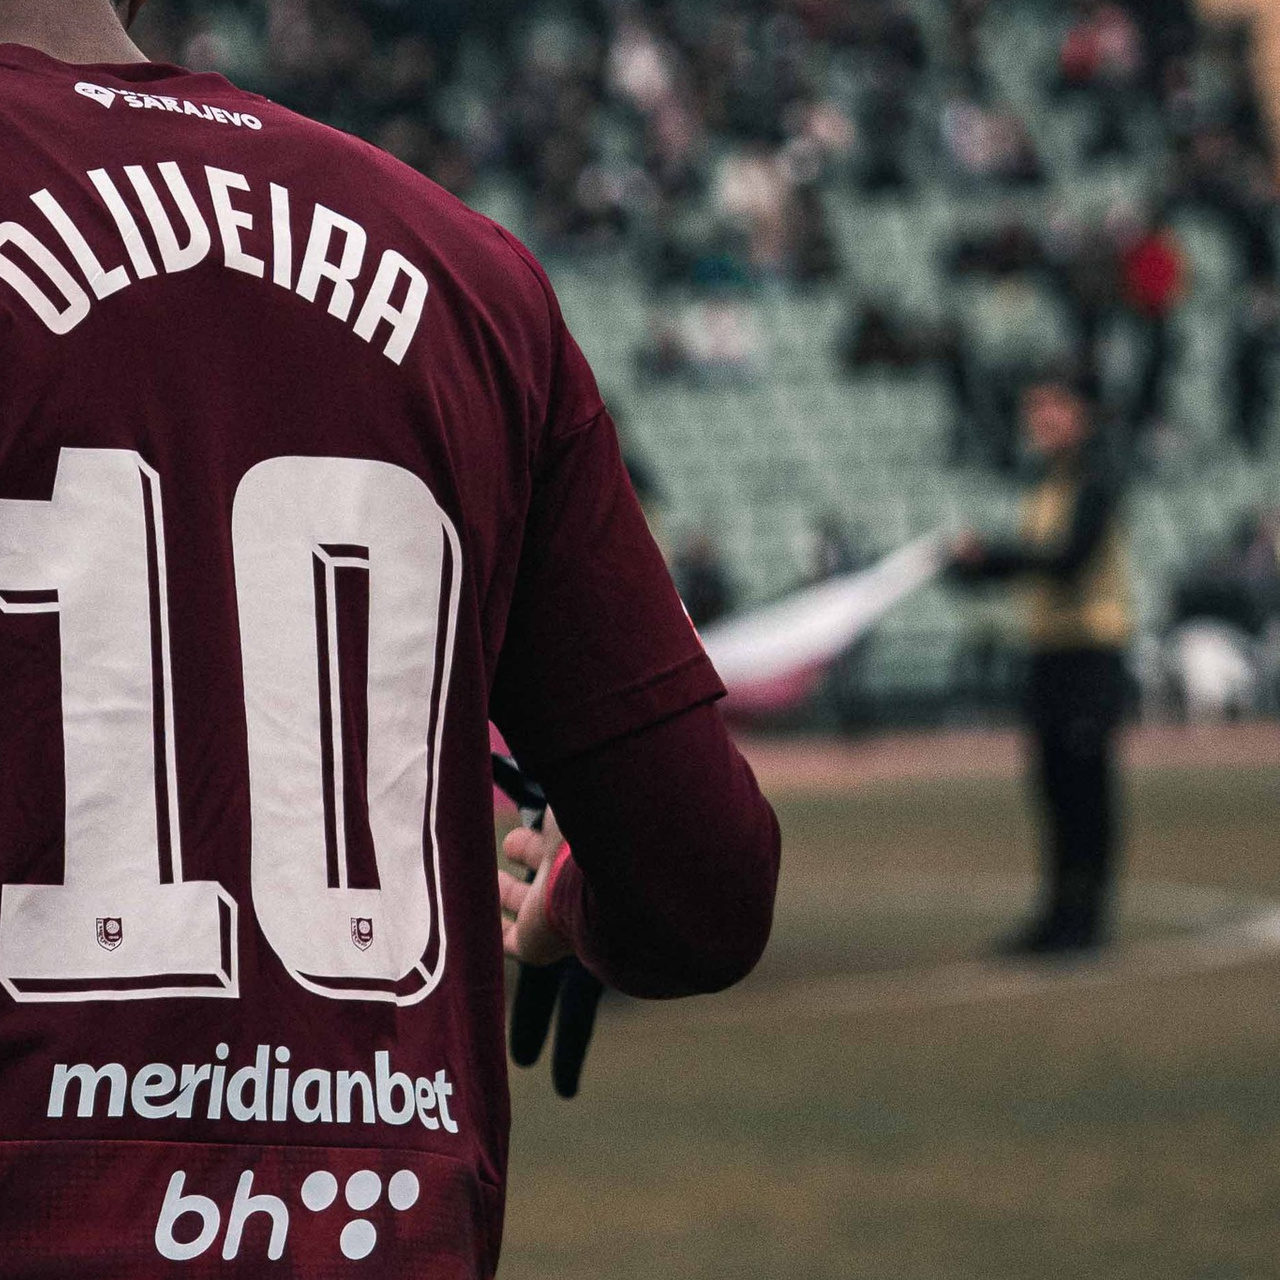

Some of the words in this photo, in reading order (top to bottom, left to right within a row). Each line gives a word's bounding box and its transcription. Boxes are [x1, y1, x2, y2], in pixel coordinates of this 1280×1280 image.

[124, 95, 263, 131] SARAJEVO
[47, 1042, 459, 1134] meridianbet
[154, 1169, 290, 1261] bh
